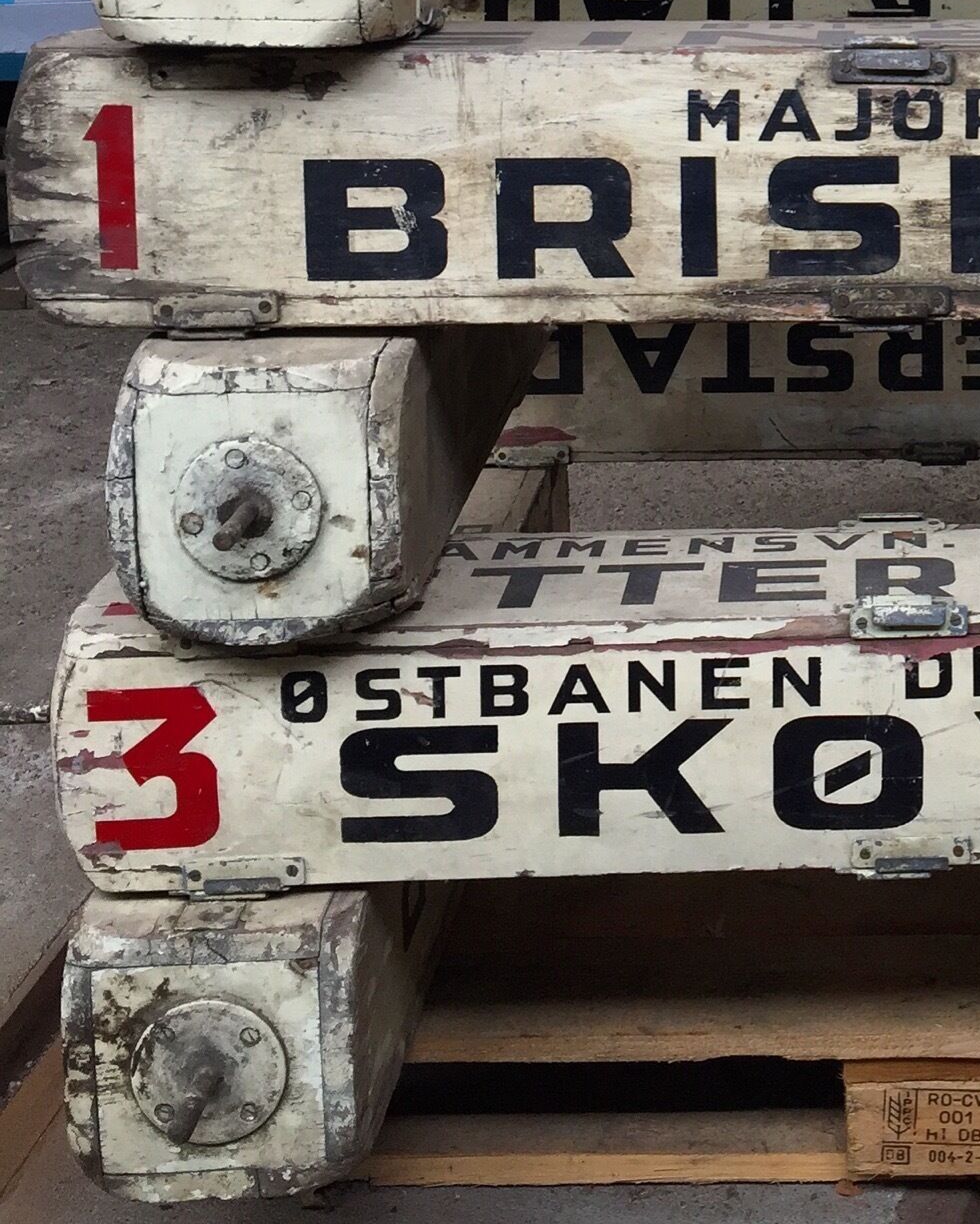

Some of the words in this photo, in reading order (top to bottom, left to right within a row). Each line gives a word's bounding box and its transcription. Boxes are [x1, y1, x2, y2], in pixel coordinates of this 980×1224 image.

[83, 104, 138, 269] 1
[281, 657, 822, 724] ØSTBANEN
[86, 686, 221, 851] 3
[939, 1110, 973, 1125] 001
